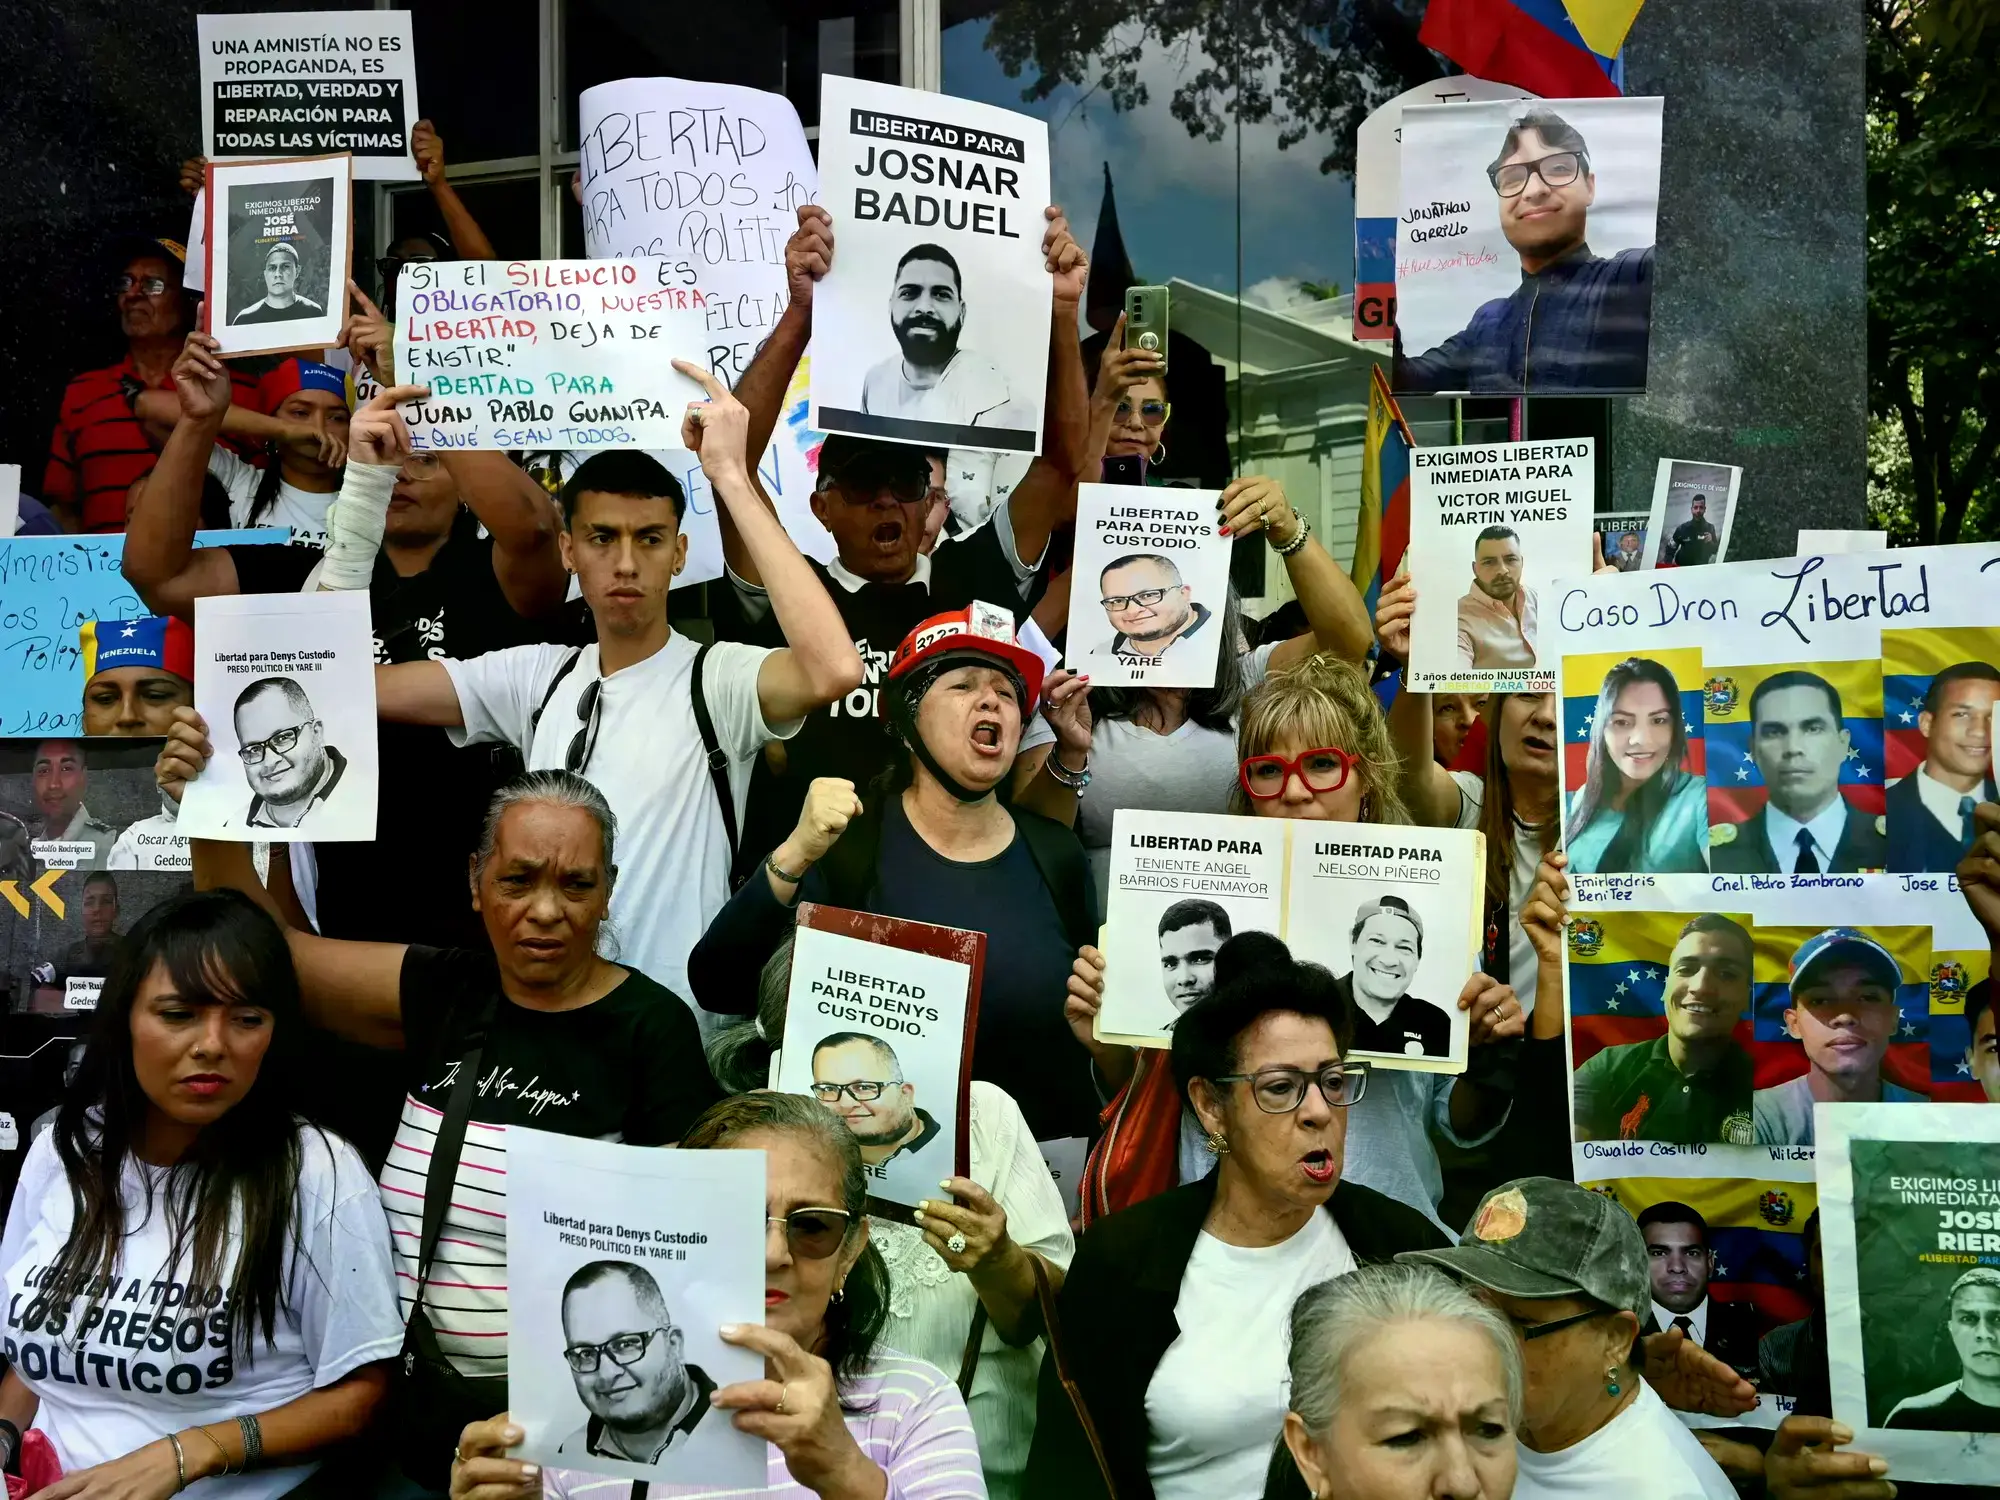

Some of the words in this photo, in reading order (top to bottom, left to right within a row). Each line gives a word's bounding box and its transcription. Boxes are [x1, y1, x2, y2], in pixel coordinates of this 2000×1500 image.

[213, 40, 249, 54] UNA
[254, 34, 340, 53] AMNISTÍA
[346, 37, 372, 51] NO
[378, 37, 401, 51] ES
[225, 59, 356, 75] PROPAGANDA,
[363, 59, 384, 73] ES
[218, 84, 303, 100] LIBERTAD,
[307, 84, 382, 97] VERDAD
[387, 83, 399, 97] Y
[225, 105, 337, 122] REPARACIÓN
[343, 109, 392, 122] PARA
[217, 134, 274, 147] TODAS
[280, 134, 313, 147] LAS
[317, 130, 402, 148] VÍCTIMAS
[857, 115, 958, 144] LIBERTAD
[965, 132, 1019, 158] PARA
[581, 107, 766, 190] IBERTAD
[855, 147, 1020, 199] JOSNAR
[245, 200, 282, 209] EXIGIMOS
[284, 197, 320, 206] LIBERTAD
[249, 207, 291, 216] INMEDIATA
[582, 188, 626, 245] ARA
[626, 171, 758, 213] TODOS
[265, 213, 294, 226] JOSÉ
[854, 188, 1019, 238] BADUEL
[263, 225, 298, 236] RIERA
[679, 211, 785, 265] POLÍTI
[507, 262, 636, 287] SILENCIO
[658, 261, 697, 285] ES
[412, 289, 585, 316] OBLIGATORIO,
[602, 288, 706, 313] NUESTRA
[409, 316, 538, 344] LIBERTAD,
[551, 322, 614, 347] DEJA
[630, 324, 662, 339] DE
[546, 374, 613, 394] PARA
[406, 400, 472, 426] JUAN
[488, 400, 553, 422] PABLO
[569, 399, 669, 422] GUANIPA.
[494, 428, 552, 446] SEAN
[1416, 450, 1497, 467] EXIGIMOS
[1503, 444, 1588, 462] LIBERTAD
[1431, 467, 1521, 484] INMEDIATA
[1526, 465, 1573, 479] PARA
[1438, 492, 1500, 507] VICTOR
[1505, 489, 1571, 504] MIGUEL
[1110, 507, 1199, 521] LIBERTAD
[1441, 511, 1504, 525] MARTIN
[1510, 508, 1567, 522] YANES
[1096, 520, 1144, 532] PARA
[1150, 524, 1211, 536] DENYS
[1103, 535, 1200, 549] CUSTODIO.
[1560, 589, 1638, 632] Caso
[1649, 583, 1738, 627] Dron
[100, 648, 156, 660] VENEZUELA
[215, 651, 247, 662] Libertad
[249, 653, 268, 663] para
[270, 651, 296, 663] Denys
[299, 650, 336, 660] Custodio
[1118, 657, 1163, 666] YARE
[227, 665, 249, 673] PRESO
[252, 662, 282, 672] POLÍTICO
[285, 664, 294, 672] EN
[1131, 670, 1144, 679] III
[1415, 672, 1420, 680] 3
[1423, 672, 1447, 681] años
[1450, 672, 1494, 680] detenido
[1439, 682, 1490, 690] LIBERTAD
[1494, 682, 1523, 690] PARA
[32, 845, 56, 853] Rodolfo
[138, 834, 169, 844] Oscar
[170, 835, 190, 847] Agu
[1130, 835, 1212, 851] LIBERTAD
[1217, 840, 1262, 854] PARA
[1315, 843, 1394, 859] LIBERTAD
[1399, 848, 1442, 861] PARA
[49, 858, 74, 866] Gedeon
[1135, 858, 1200, 871] TENIENTE
[1204, 863, 1250, 874] ANGEL
[1319, 863, 1379, 876] NELSON
[1384, 865, 1440, 880] PIÑERO
[1120, 874, 1178, 888] BARRIOS
[1183, 879, 1267, 893] FUENMAYOR
[1751, 875, 1785, 890] Pedro
[1790, 874, 1864, 888] Zambrano
[1899, 875, 1938, 892] Jose
[70, 981, 87, 990] José
[827, 967, 926, 1000] LIBERTAD
[71, 996, 97, 1006] Gedeo
[811, 981, 862, 1004] PARA
[869, 995, 939, 1021] DENYS
[817, 1001, 926, 1038] CUSTODIO.
[517, 1076, 571, 1116] happen
[1584, 1143, 1644, 1158] Oswaldo
[1891, 1177, 1977, 1191] EXIGIMOS
[1982, 1180, 2000, 1192] LI
[1902, 1192, 2000, 1206] INMEDIATA
[544, 1211, 585, 1231] Libertad
[589, 1223, 613, 1237] para
[616, 1225, 650, 1242] Denys
[654, 1230, 707, 1245] Custodio
[560, 1233, 587, 1248] PRESO
[590, 1239, 631, 1254] POLÍTICO
[634, 1246, 646, 1256] EN
[649, 1247, 672, 1259] YARE
[676, 1250, 686, 1260] III
[1938, 1232, 2000, 1251] RIER
[122, 1279, 141, 1302] A
[150, 1280, 241, 1310] TODOS
[8, 1293, 71, 1335] LOS
[77, 1306, 232, 1353] PRESOS
[4, 1335, 233, 1395] POLÍTICOS
